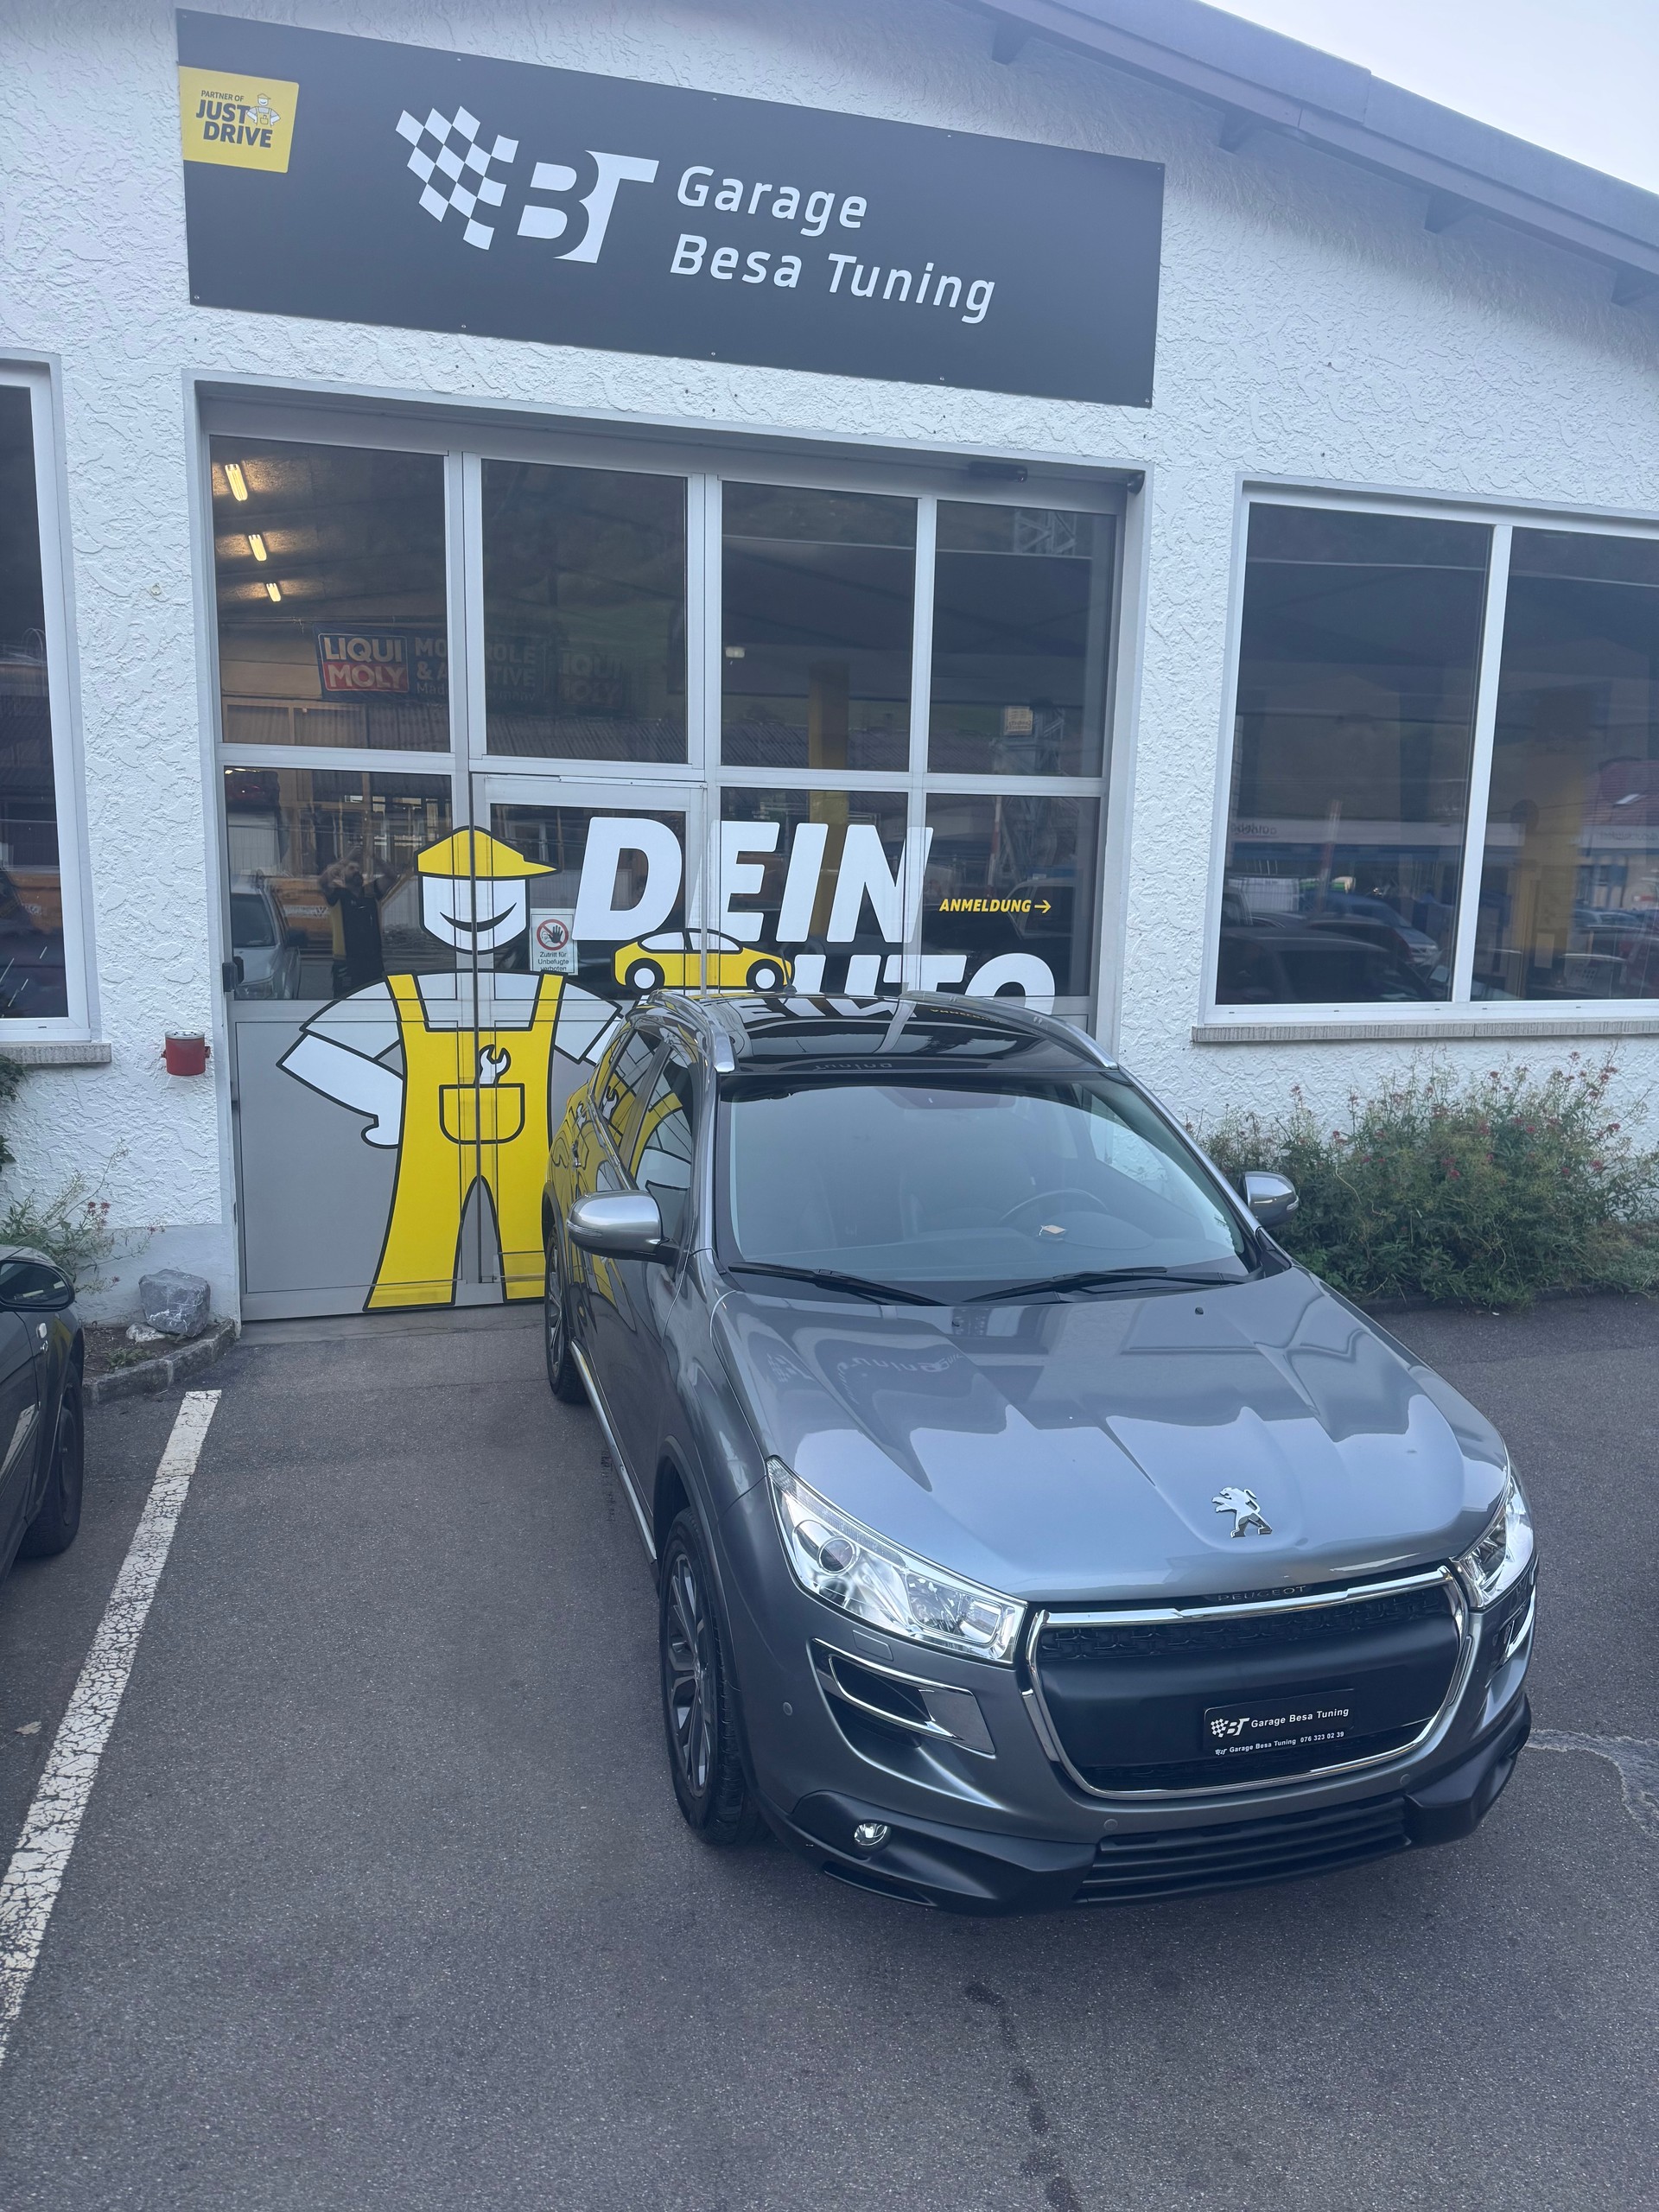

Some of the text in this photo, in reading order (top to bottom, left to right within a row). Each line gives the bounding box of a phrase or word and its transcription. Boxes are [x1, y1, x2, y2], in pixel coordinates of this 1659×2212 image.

[200, 90, 233, 101] PARTNER
[195, 99, 251, 124] JUST
[203, 120, 273, 148] DRIVE
[677, 165, 868, 237] Garage
[670, 233, 995, 323] Besa Tuning
[323, 637, 402, 663] LIQUI
[327, 664, 405, 689] MOLY
[572, 817, 933, 943] DEIN
[939, 899, 1031, 913] ANMELDUNG
[1217, 1585, 1306, 1601] PEUGEOT
[1251, 1717, 1286, 1728] Garage
[1289, 1713, 1313, 1723] Besa
[1316, 1708, 1350, 1719] Tuning
[1274, 1738, 1297, 1747] Tuning
